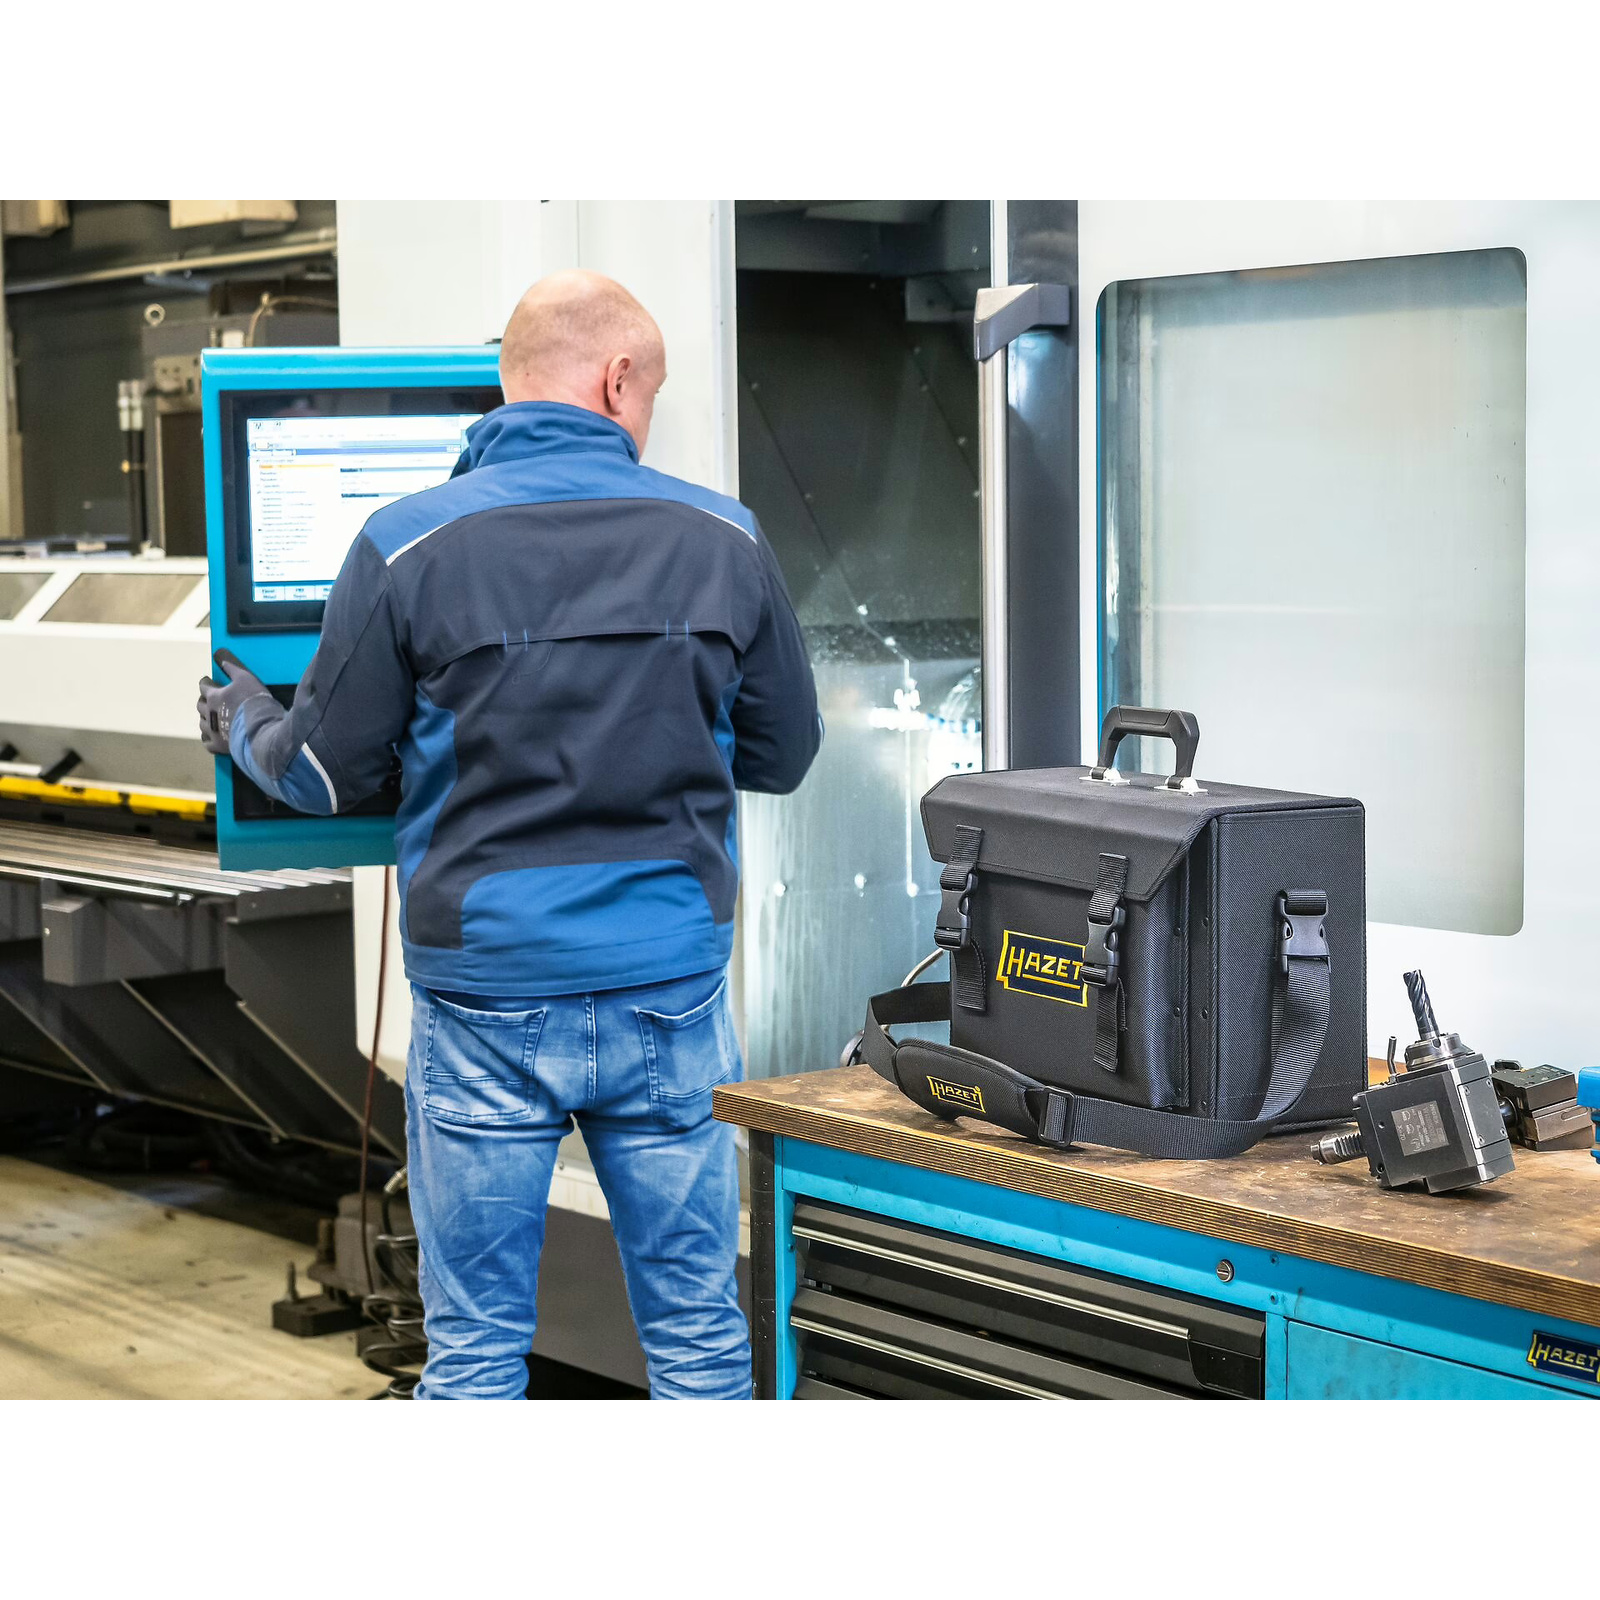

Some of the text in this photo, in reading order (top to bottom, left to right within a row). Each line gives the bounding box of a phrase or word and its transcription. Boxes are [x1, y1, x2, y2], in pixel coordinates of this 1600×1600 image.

[1006, 946, 1084, 981] HAZET
[934, 1081, 978, 1102] HAZET
[1535, 1342, 1599, 1368] HAZET
